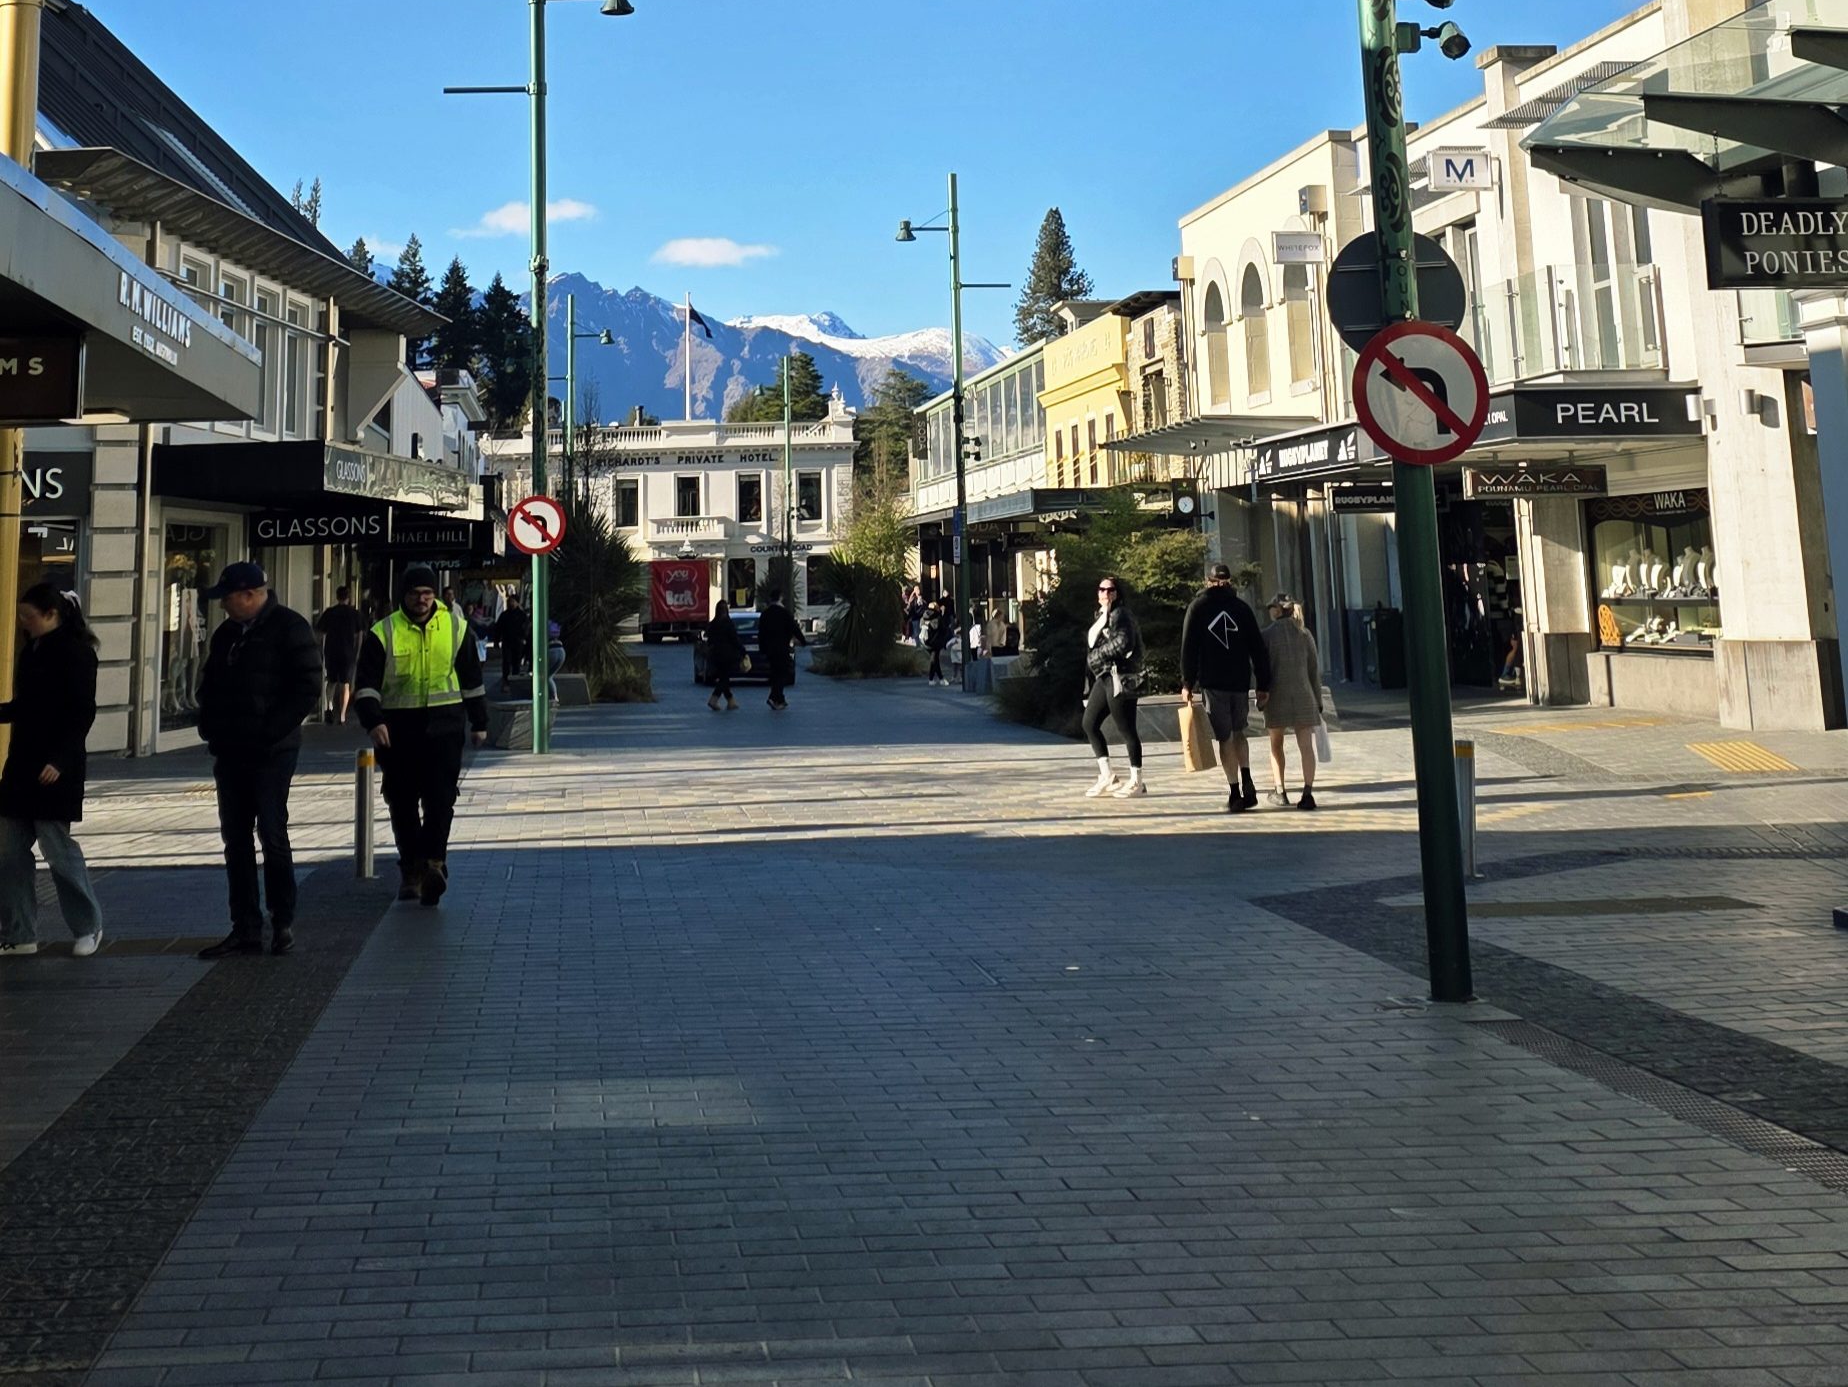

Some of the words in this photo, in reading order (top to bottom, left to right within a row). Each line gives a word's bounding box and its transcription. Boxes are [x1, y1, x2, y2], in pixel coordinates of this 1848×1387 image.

[1740, 211, 1848, 235] DEADLY
[1744, 249, 1848, 274] PONIES
[1556, 402, 1660, 425] PEARL
[917, 420, 927, 451] SODA
[677, 454, 725, 464] PRIVATE
[257, 515, 381, 539] GLASSONS
[435, 530, 467, 543] HILL
